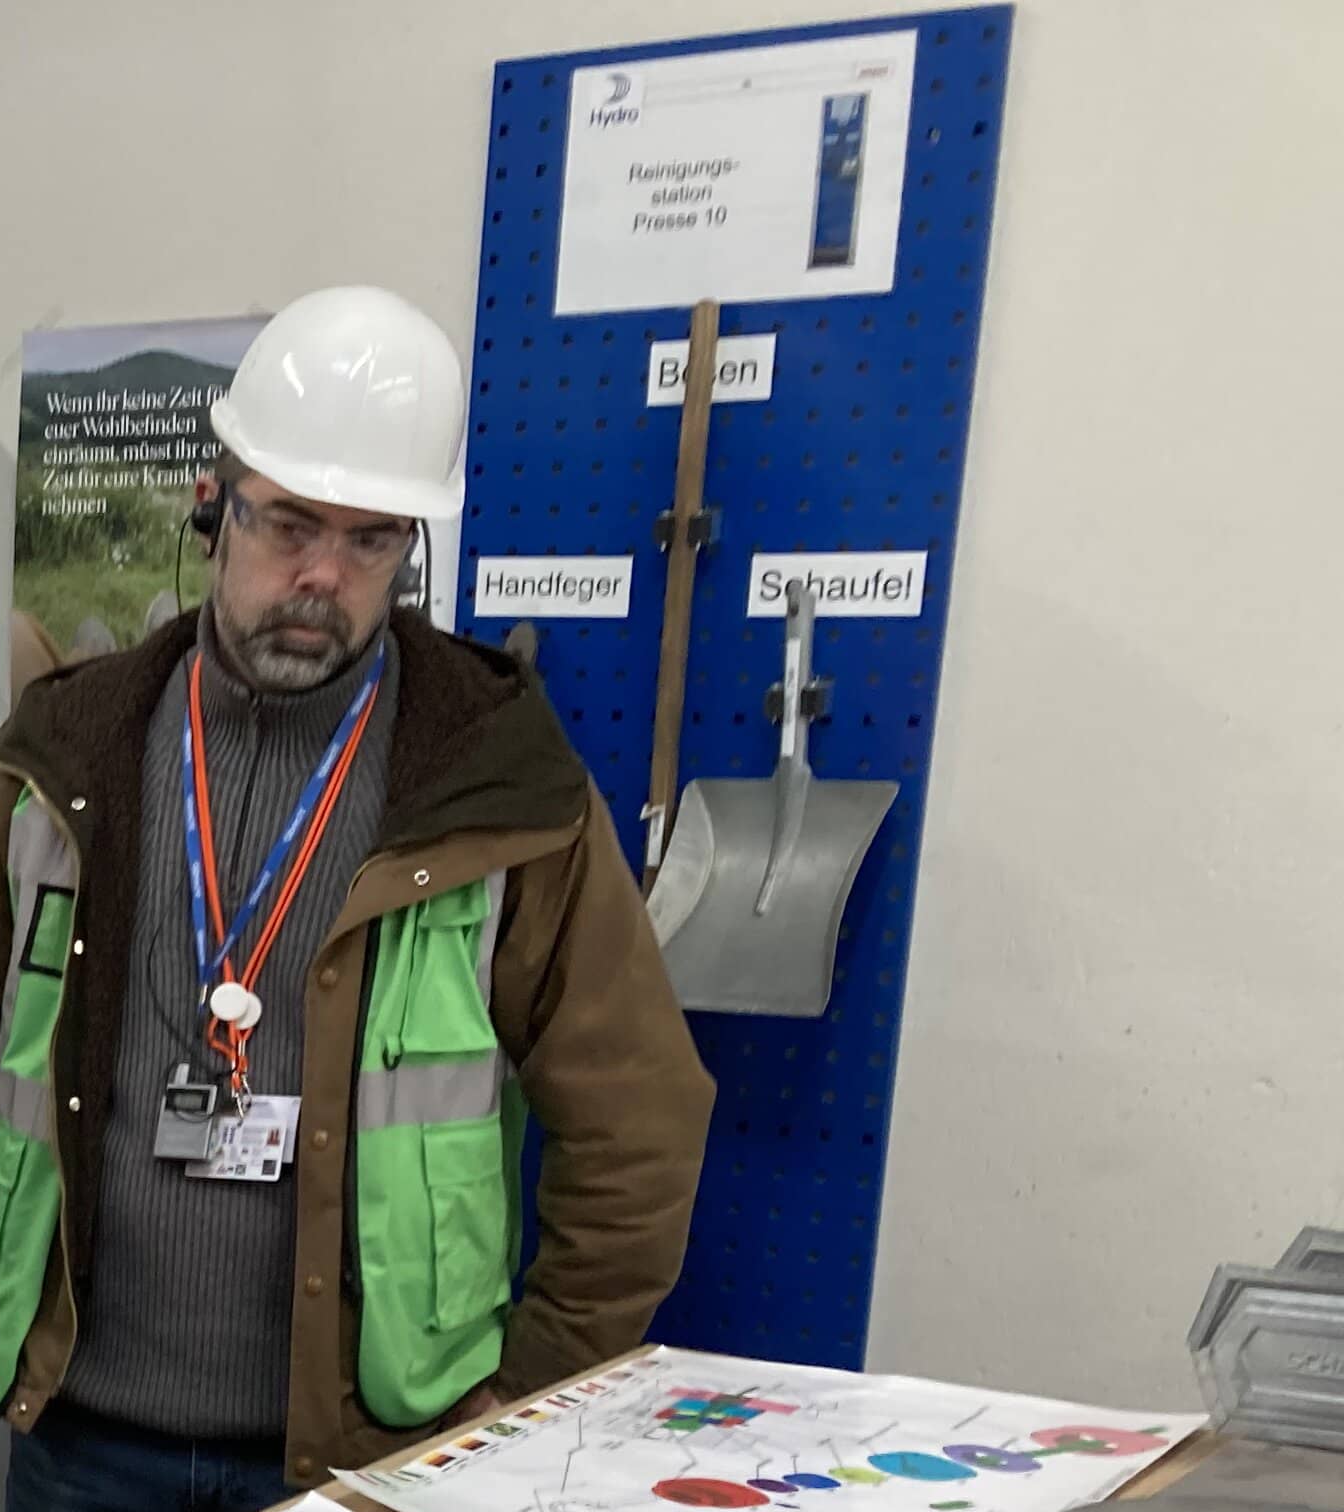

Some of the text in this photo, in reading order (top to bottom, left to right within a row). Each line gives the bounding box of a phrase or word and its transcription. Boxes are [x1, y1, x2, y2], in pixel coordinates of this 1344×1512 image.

[589, 105, 639, 129] Hydro
[628, 157, 740, 184] Reinigungs-
[651, 183, 712, 206] station
[632, 203, 728, 234] Presse 10
[658, 357, 758, 390] Ben
[47, 391, 94, 415] Wenn
[122, 387, 167, 411] keine
[169, 385, 202, 409] Zeit
[44, 411, 197, 441] euer Wohlbefinden
[123, 440, 171, 463] müsst
[77, 467, 100, 489] für
[104, 469, 140, 489] eure
[42, 495, 107, 517] nehmen
[484, 569, 622, 604] Handfeger
[760, 567, 913, 601] Schaufel
